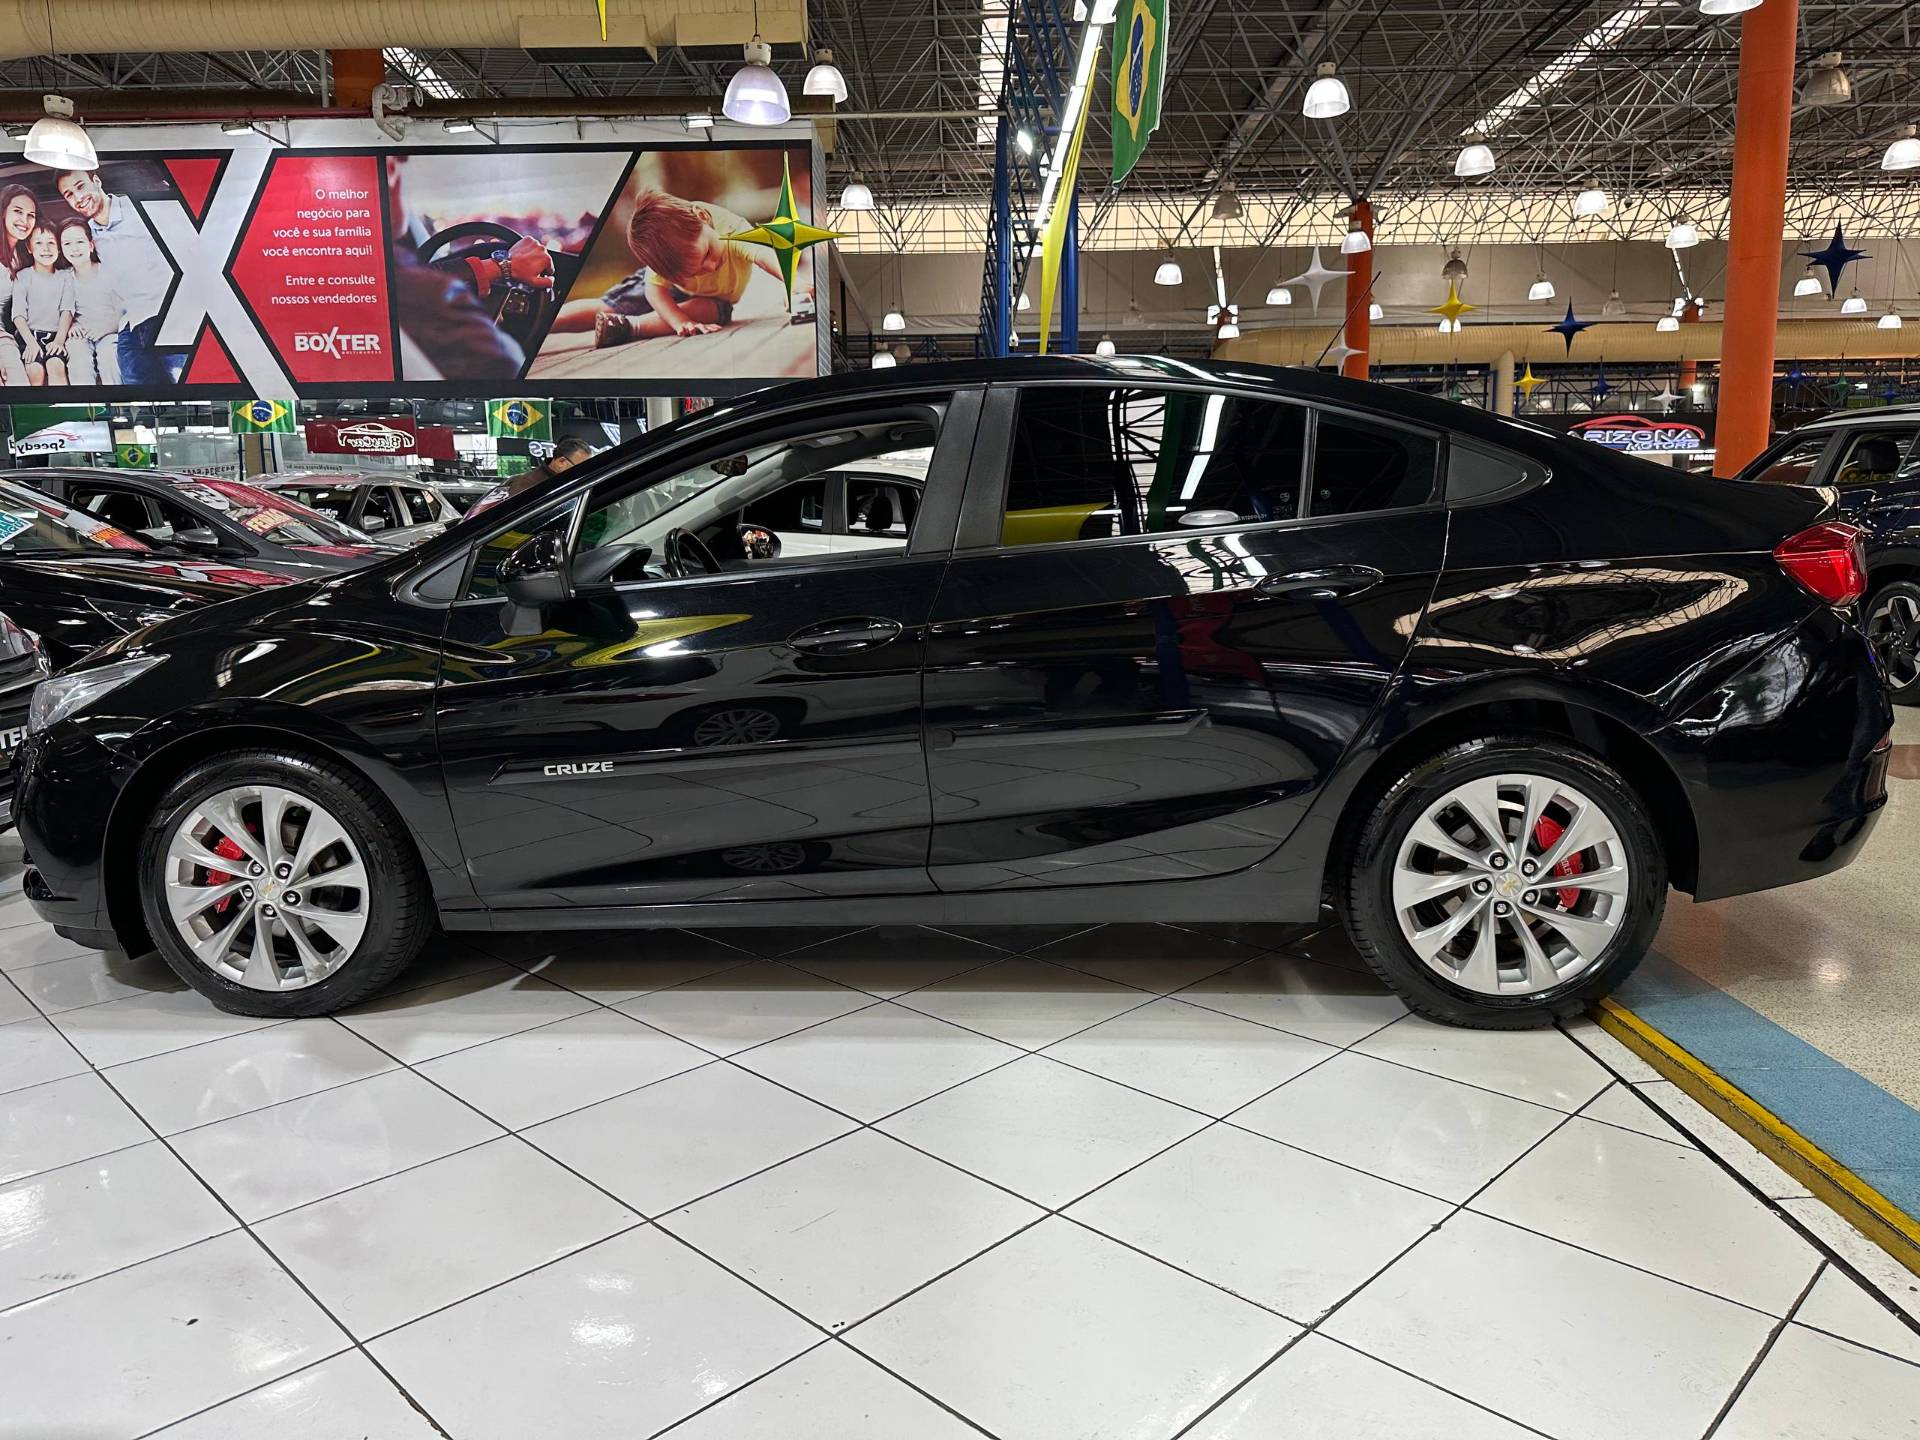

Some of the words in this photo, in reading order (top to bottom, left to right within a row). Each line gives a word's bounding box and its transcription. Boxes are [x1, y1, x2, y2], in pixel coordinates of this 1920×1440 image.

[315, 189, 326, 200] O
[328, 189, 369, 200] melhor
[297, 208, 342, 221] negócio
[346, 209, 370, 220] para
[272, 227, 300, 238] você
[313, 229, 332, 237] sua
[335, 226, 372, 237] família
[262, 246, 290, 257] você
[292, 246, 342, 256] encontra
[345, 245, 373, 258] aqui!
[286, 275, 315, 286] Entre
[317, 277, 325, 286] e
[327, 275, 375, 285] consulte
[271, 295, 309, 304] nossos
[312, 293, 377, 304] vendedores
[294, 326, 381, 359] BOXTER
[543, 761, 615, 776] CRUZE
